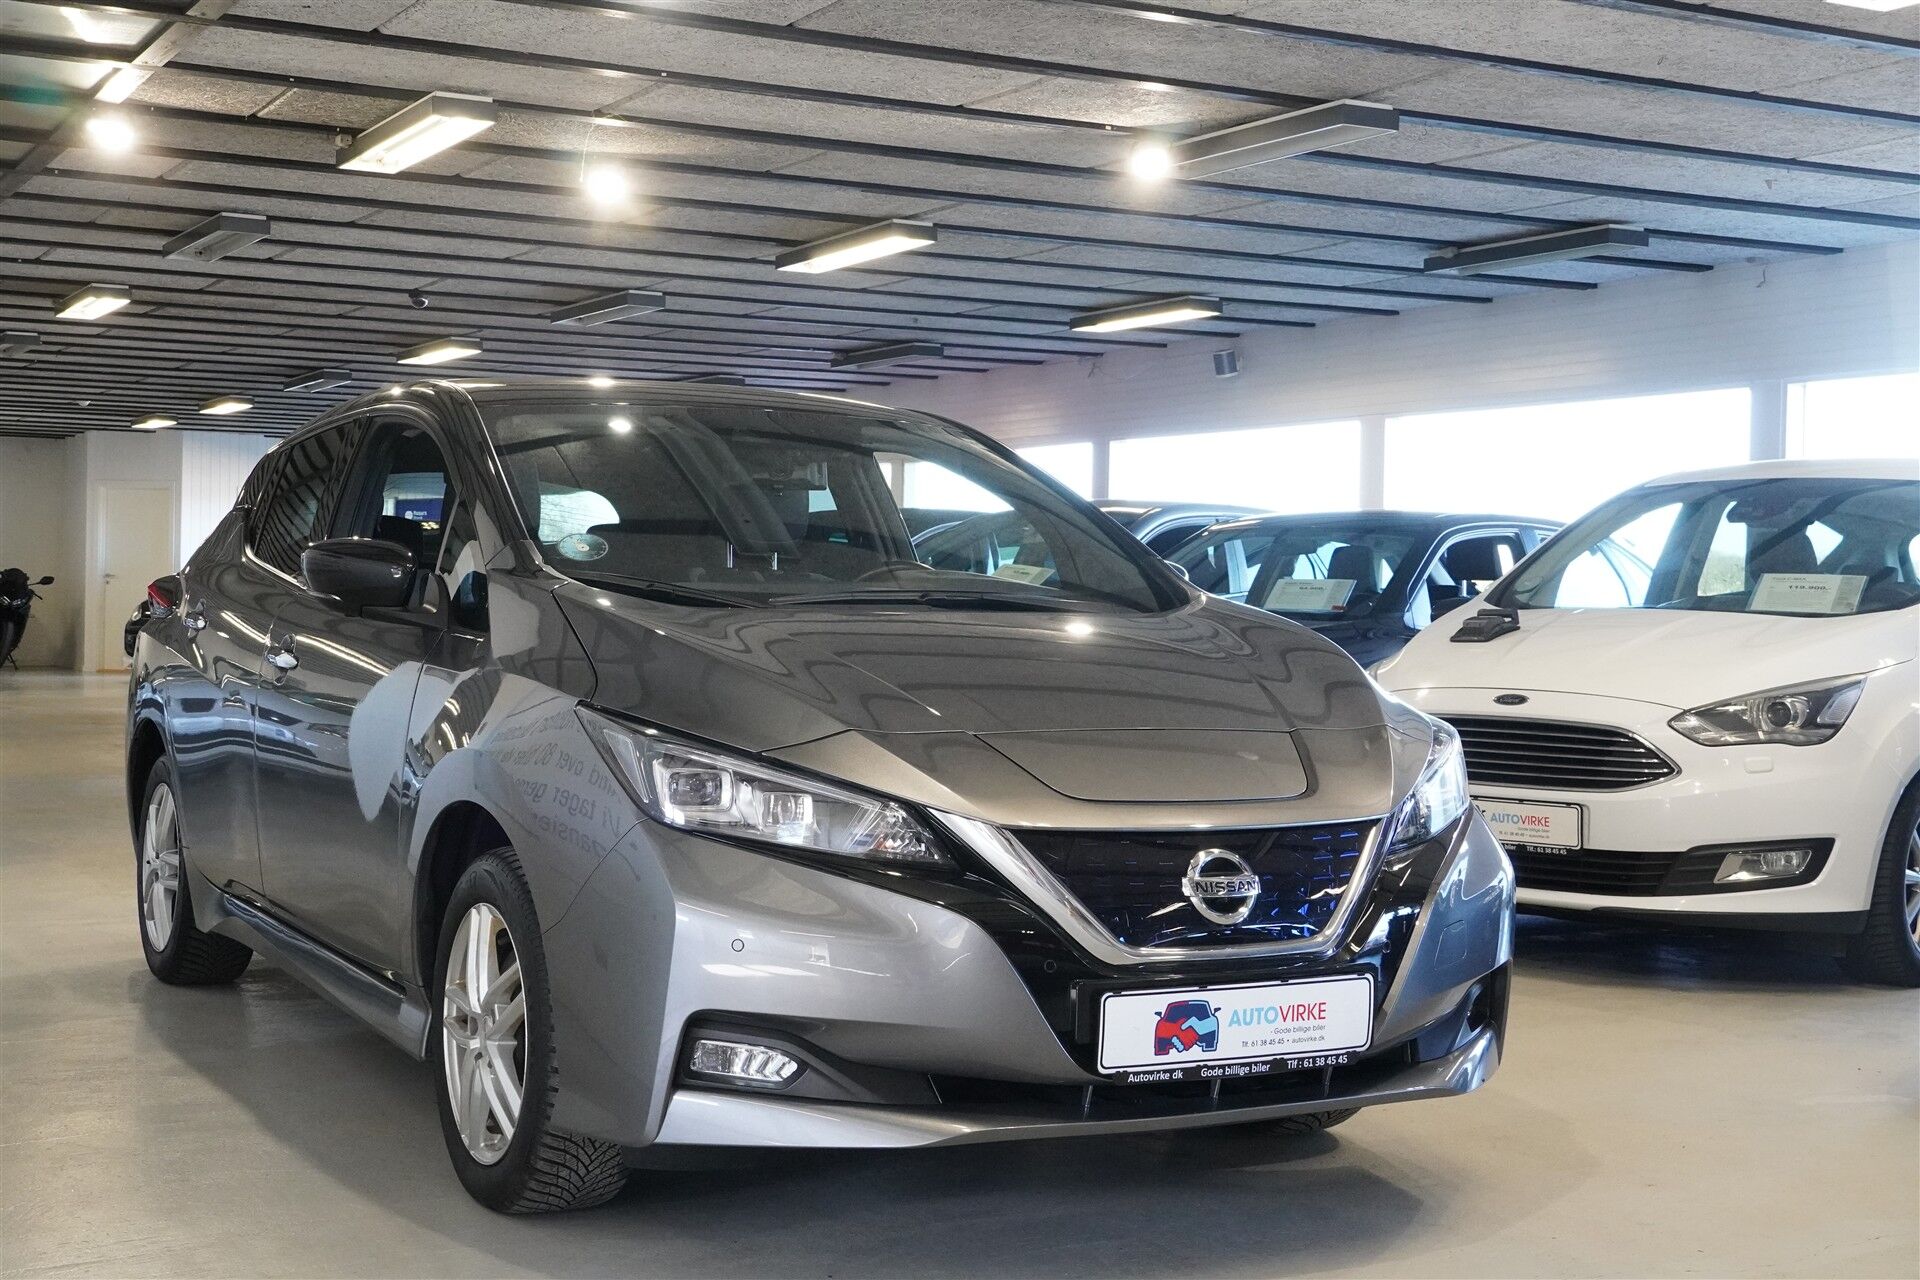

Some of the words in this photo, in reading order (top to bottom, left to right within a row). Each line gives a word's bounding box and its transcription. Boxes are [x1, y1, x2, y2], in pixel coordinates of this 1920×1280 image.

[1491, 812, 1550, 827] AUTOVIRKE
[1195, 880, 1255, 893] NISSAN
[1228, 1002, 1326, 1027] AUTOVIRKE
[1274, 1027, 1291, 1036] Gode
[1293, 1025, 1311, 1034] billige
[1251, 1039, 1258, 1047] 61
[1260, 1039, 1267, 1047] 38
[1269, 1038, 1276, 1046] 45
[1277, 1037, 1285, 1045] 45
[1303, 1058, 1313, 1068] 61
[1315, 1057, 1325, 1067] 38
[1326, 1055, 1336, 1065] 45
[1338, 1054, 1348, 1064] 45
[1200, 1067, 1223, 1077] Gode
[1224, 1064, 1250, 1076] billige
[1251, 1063, 1271, 1073] biler
